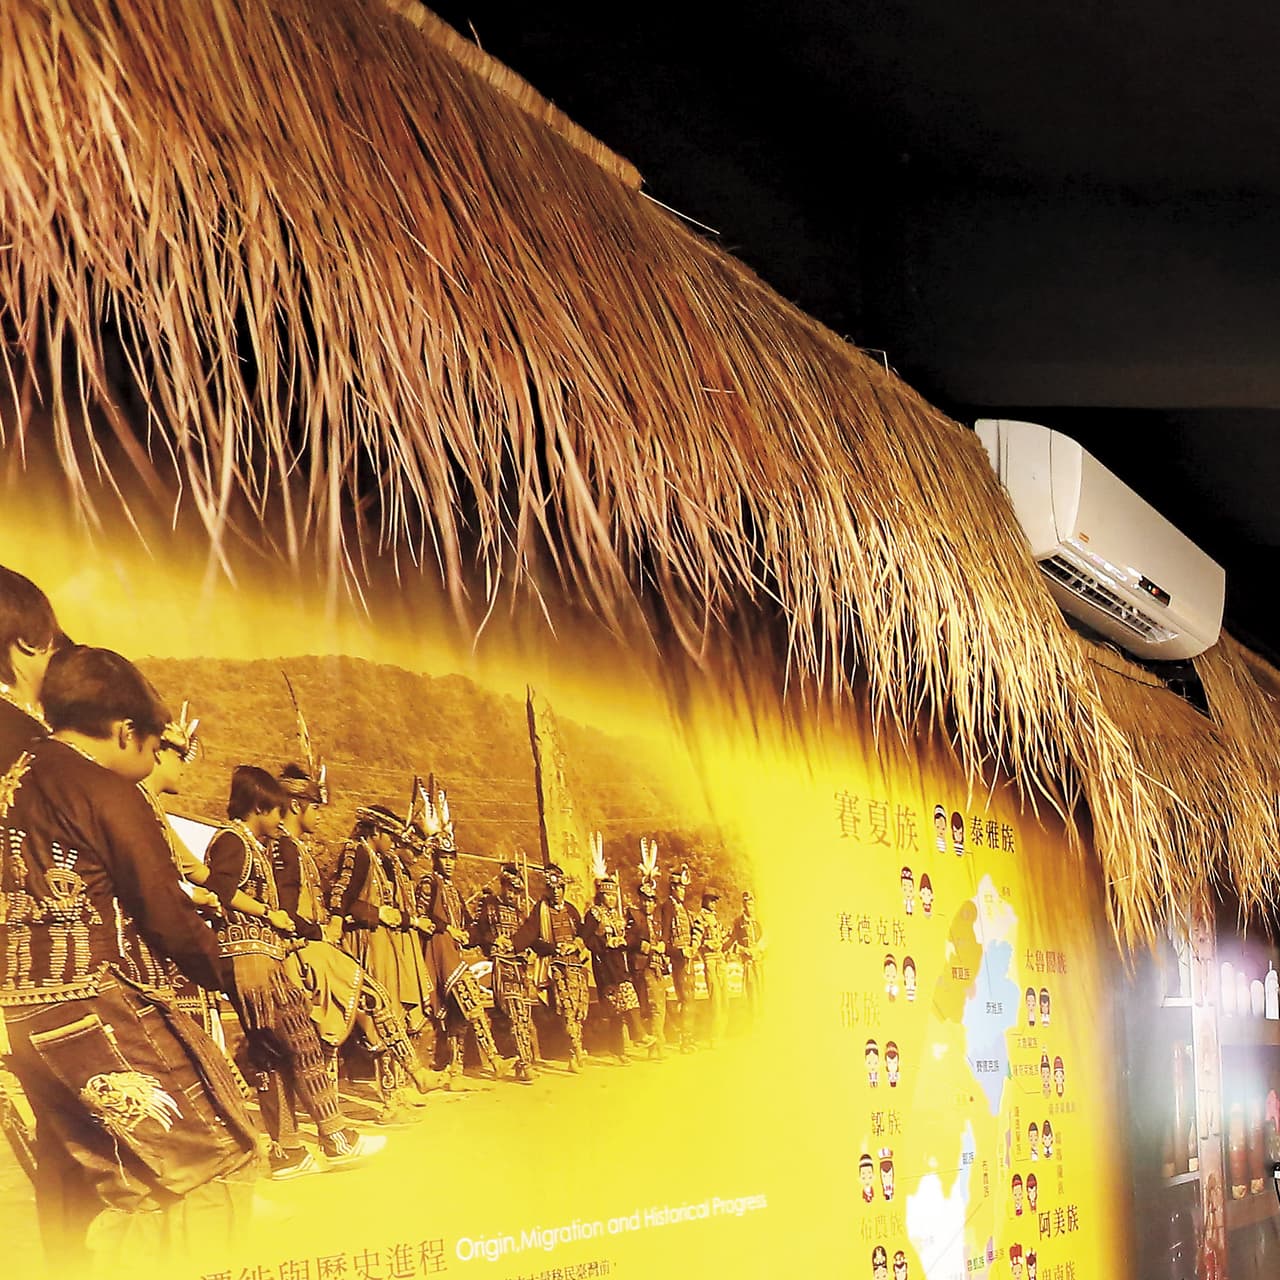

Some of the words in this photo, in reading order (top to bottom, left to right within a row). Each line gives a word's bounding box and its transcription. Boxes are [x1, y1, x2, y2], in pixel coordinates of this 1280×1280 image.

[834, 789, 919, 852] 賽夏族
[969, 815, 1015, 853] 泰雅族
[839, 911, 906, 947] 賽德克族
[607, 1209, 641, 1234] and
[644, 1197, 711, 1227] Historical
[713, 1191, 767, 1219] Progress
[1038, 1204, 1079, 1241] 阿美族
